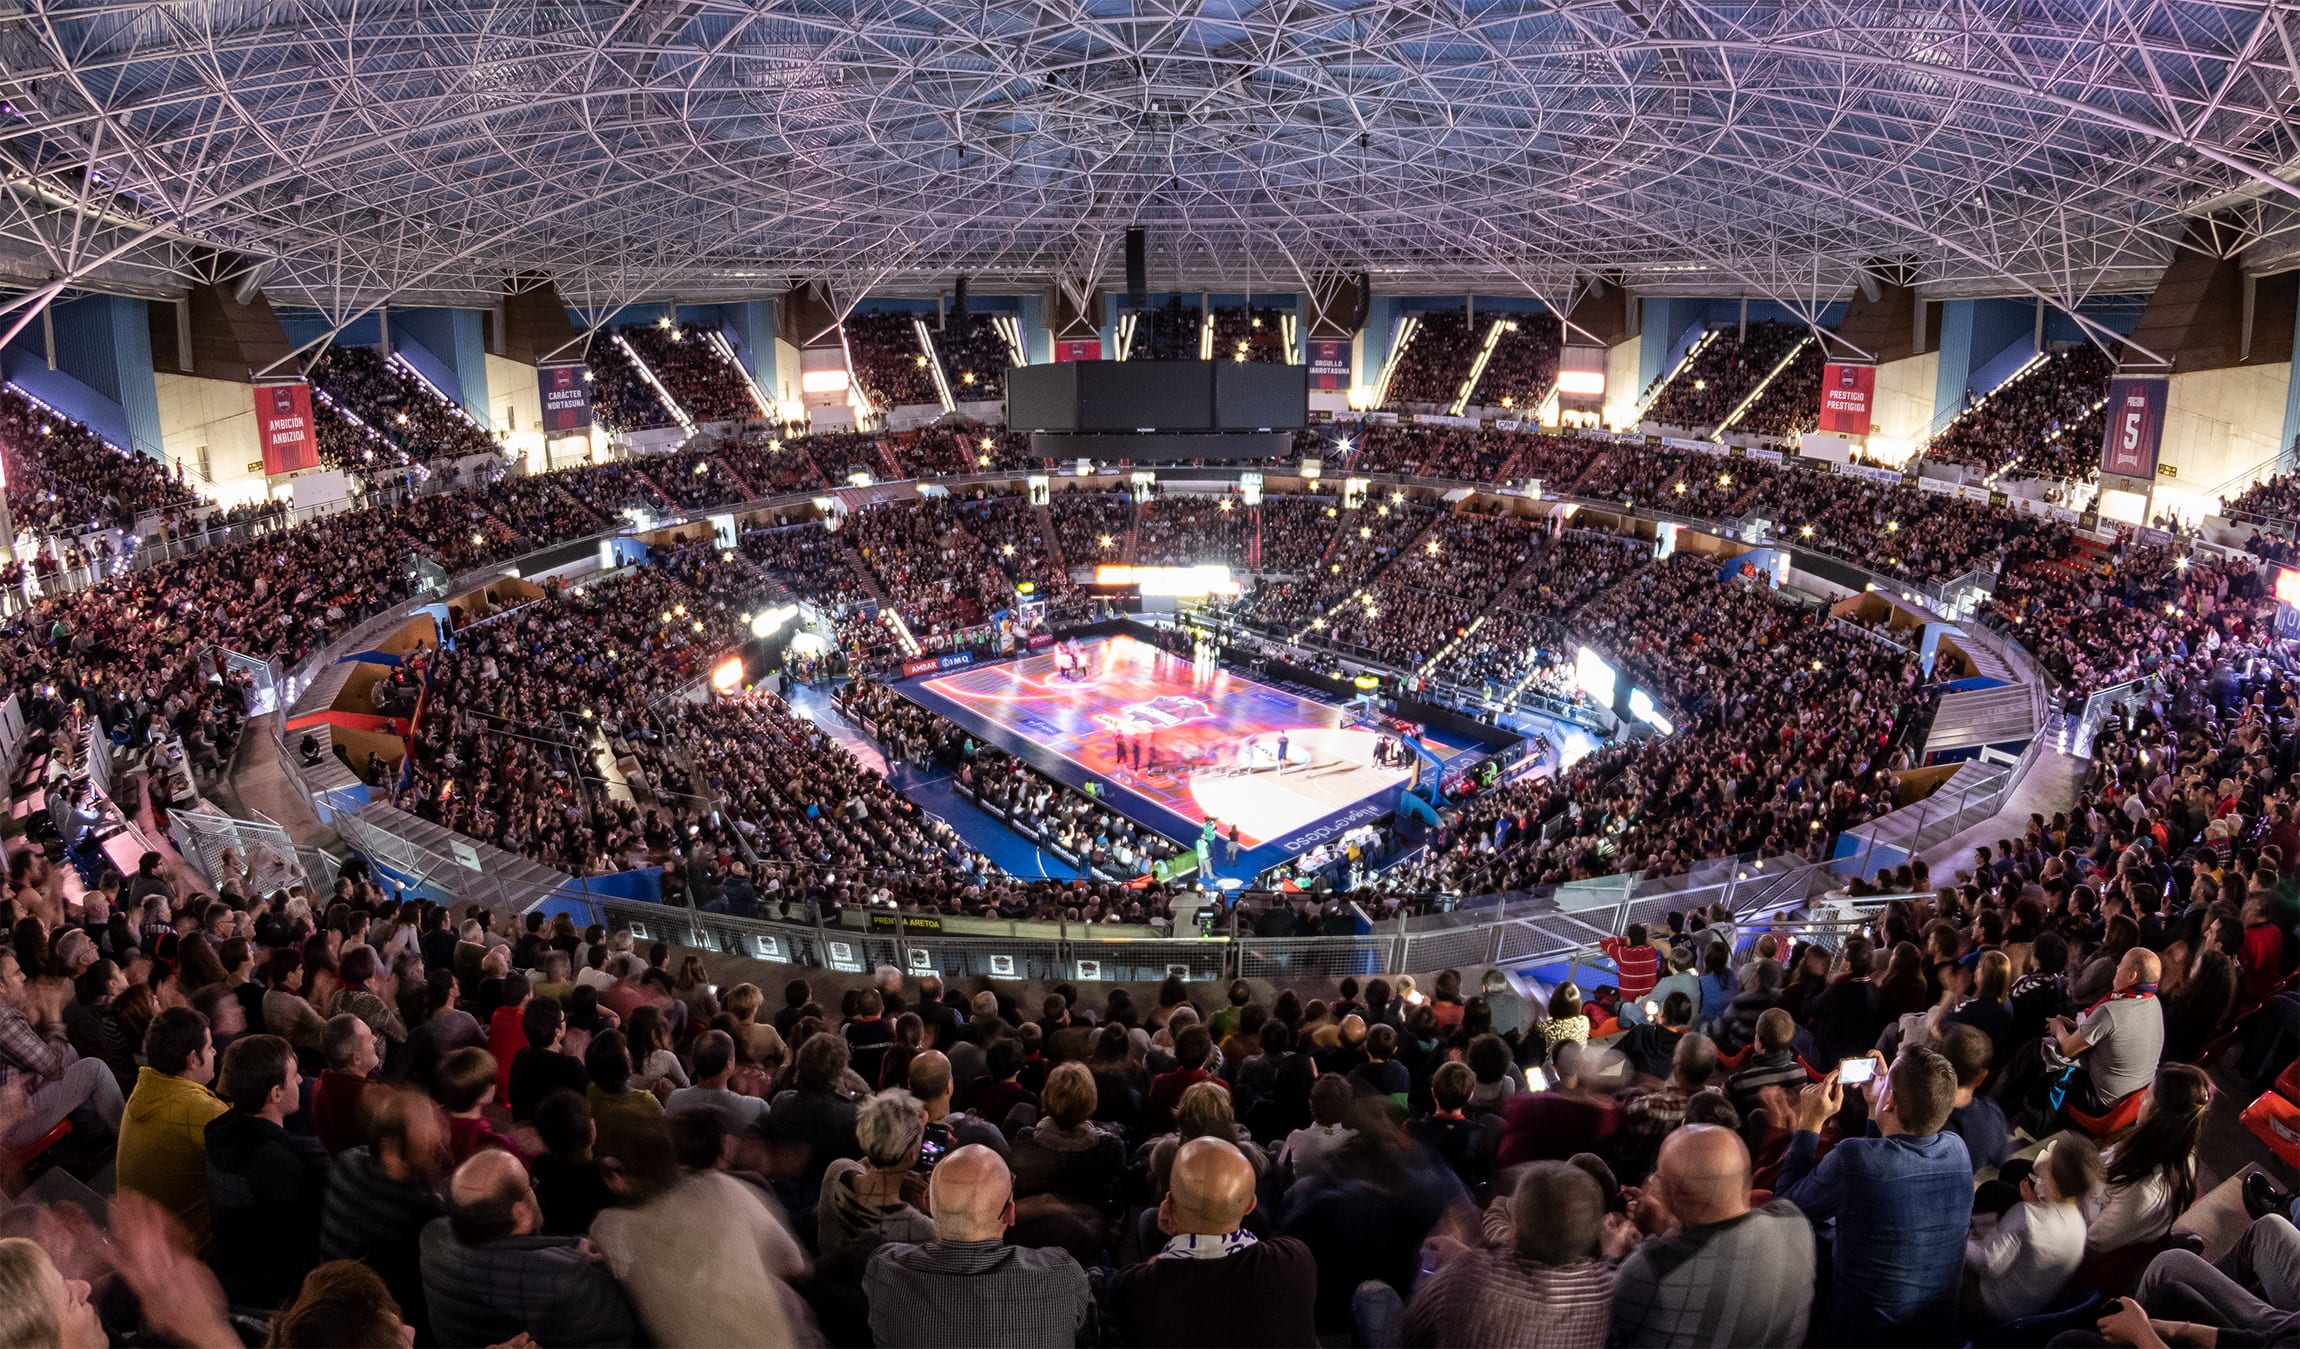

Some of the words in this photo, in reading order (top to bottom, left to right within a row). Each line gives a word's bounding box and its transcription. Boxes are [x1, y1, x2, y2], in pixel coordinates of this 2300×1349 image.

[548, 389, 582, 400] CARÁCTER
[1830, 390, 1865, 402] PRESTIGIO
[547, 399, 585, 410] NORTASUNA
[1826, 400, 1866, 412] PRESTIGIOA
[269, 415, 304, 431] AMBICIÓN
[272, 430, 305, 445] ANBIZIOA
[2123, 413, 2141, 450] 5
[911, 661, 937, 673] AMBAR
[1284, 804, 1380, 851] #ligaendesa
[909, 919, 940, 928] ARETOA
